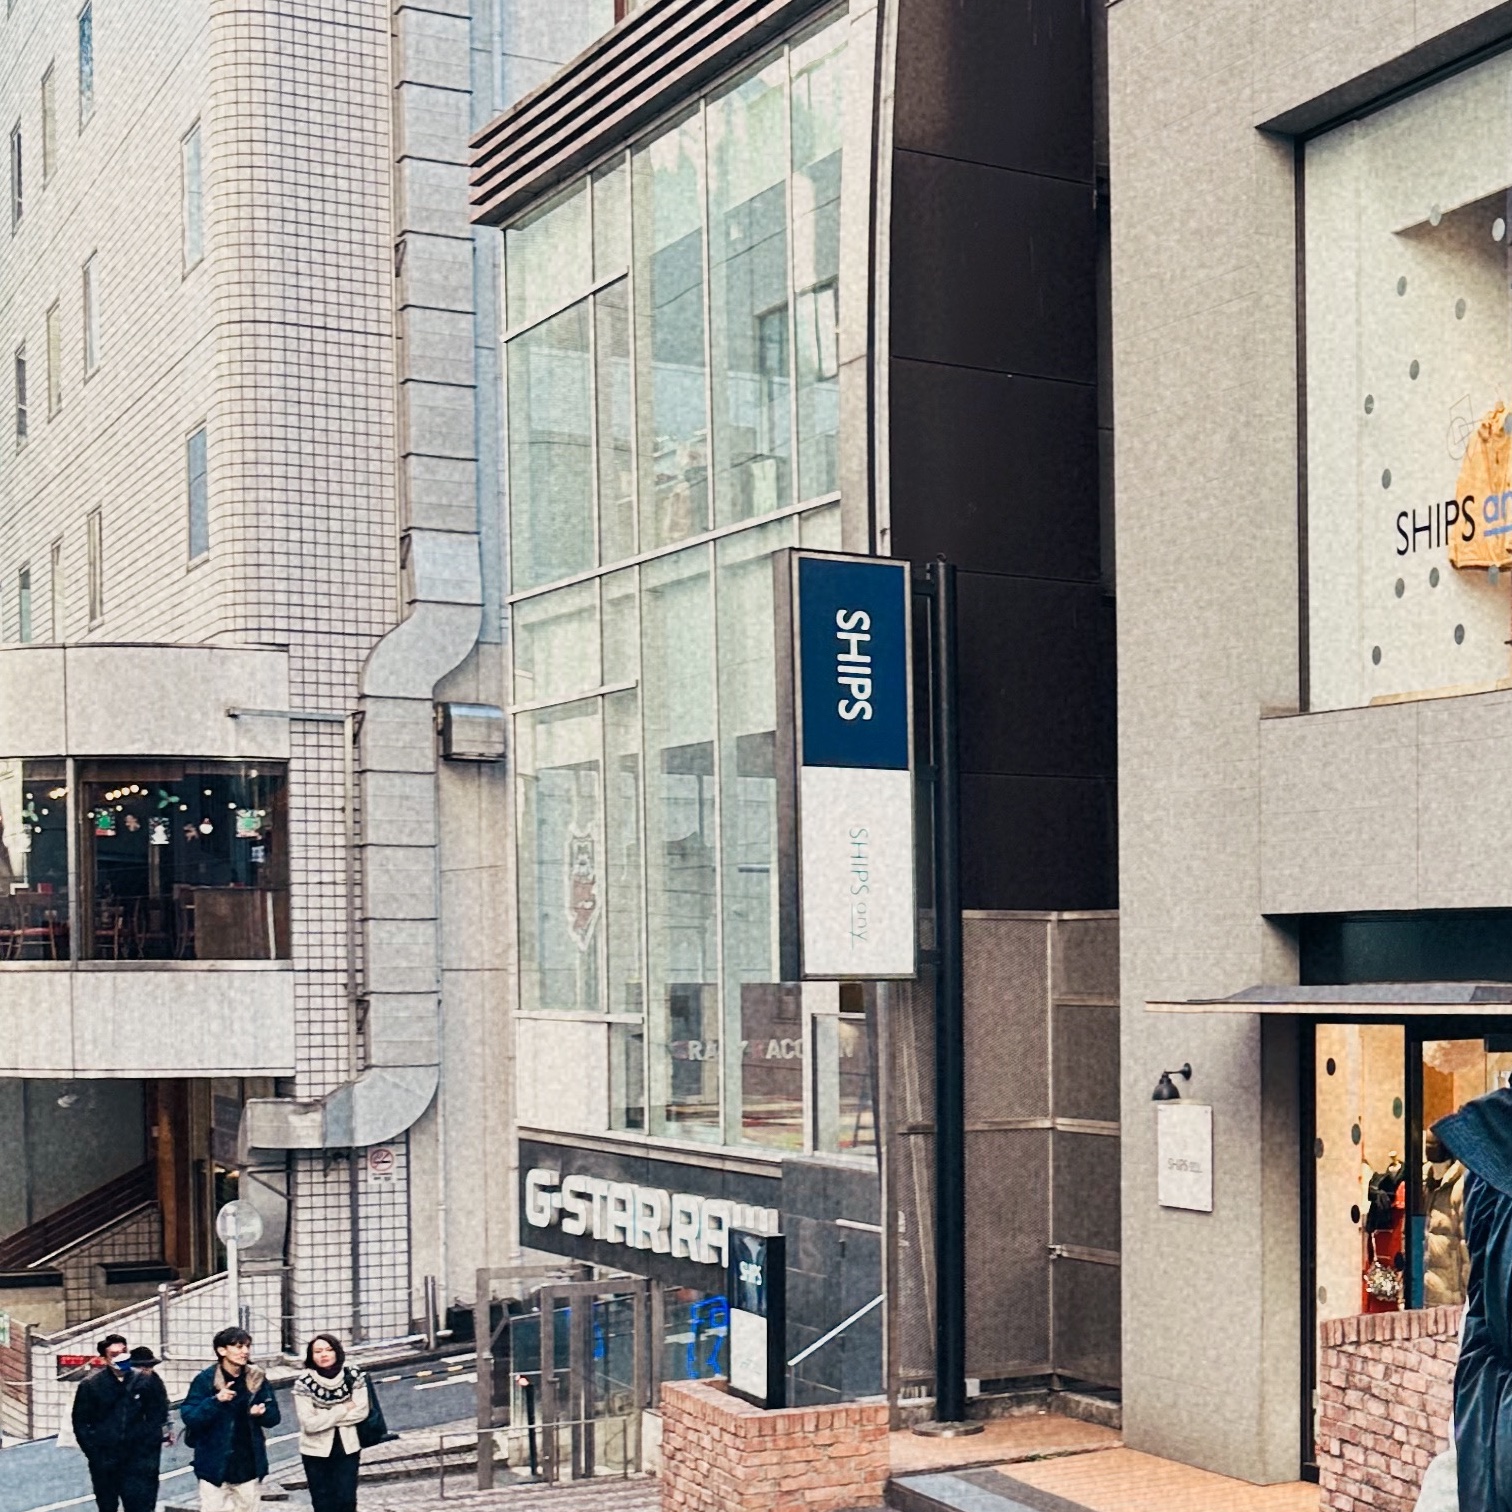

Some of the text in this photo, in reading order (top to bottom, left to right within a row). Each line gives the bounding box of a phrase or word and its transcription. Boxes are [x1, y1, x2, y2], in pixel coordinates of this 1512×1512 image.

[1396, 495, 1476, 556] SHIPS
[836, 609, 873, 721] SHIPS
[849, 828, 870, 942] SHIPS any
[525, 1168, 670, 1254] G-STAR
